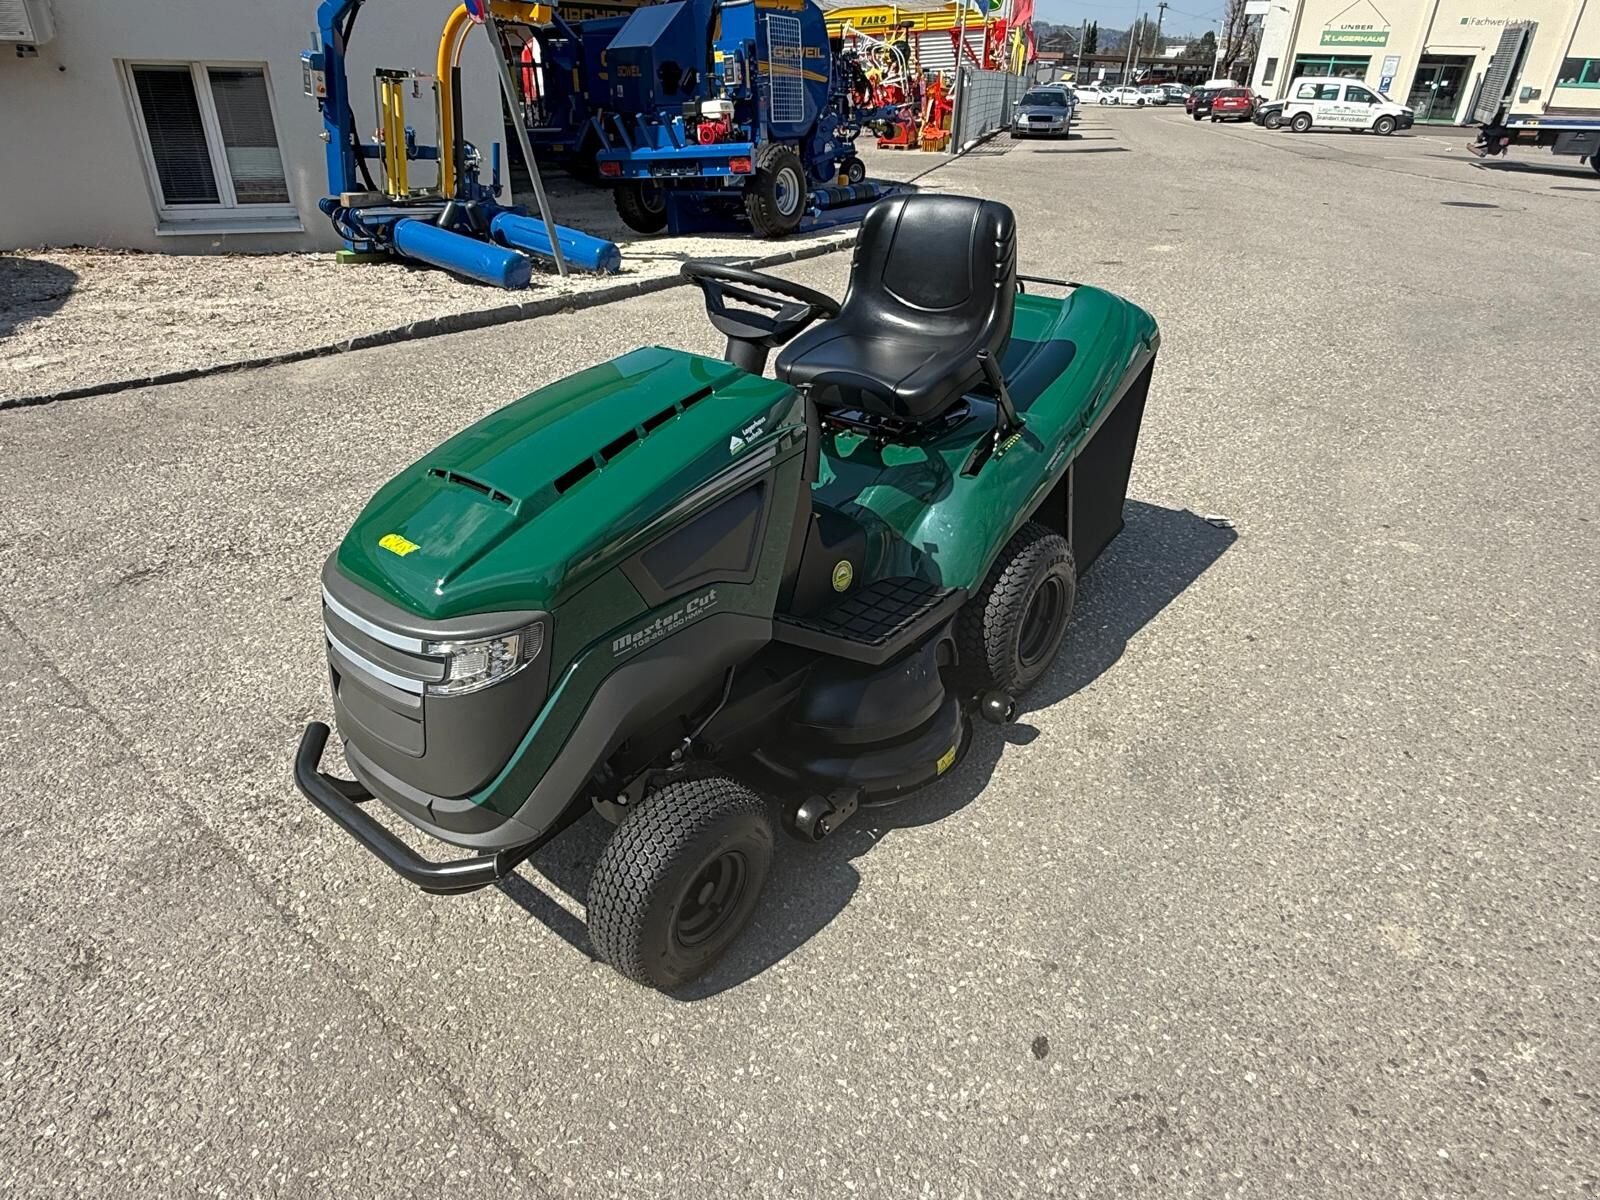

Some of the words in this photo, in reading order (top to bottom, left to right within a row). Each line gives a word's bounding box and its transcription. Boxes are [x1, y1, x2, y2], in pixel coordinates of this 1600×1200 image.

[861, 16, 887, 26] FARO
[1331, 35, 1386, 43] LAGERHAUS
[1382, 77, 1390, 87] P
[612, 608, 684, 652] Master
[686, 588, 718, 613] Cut
